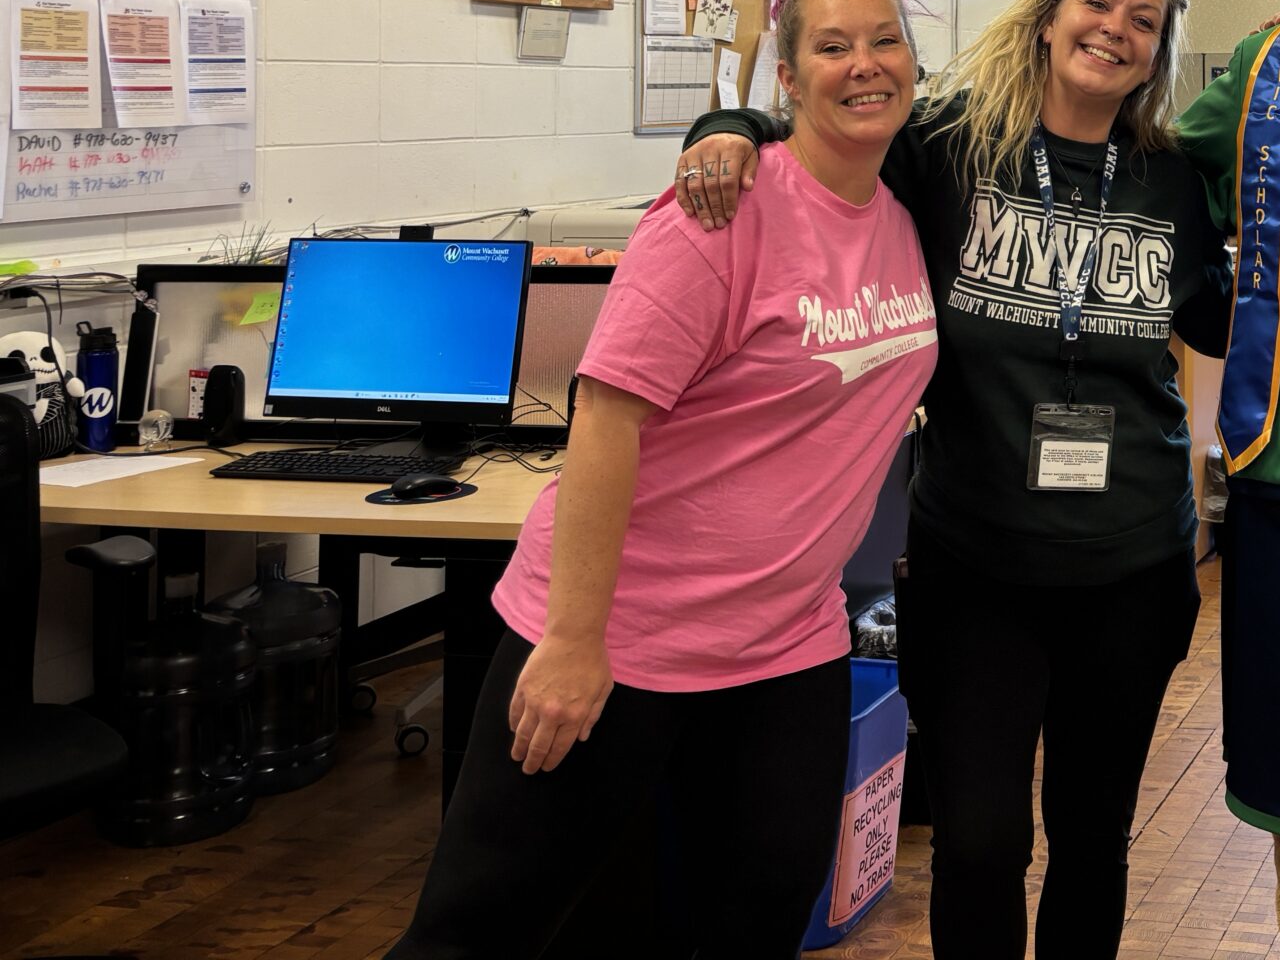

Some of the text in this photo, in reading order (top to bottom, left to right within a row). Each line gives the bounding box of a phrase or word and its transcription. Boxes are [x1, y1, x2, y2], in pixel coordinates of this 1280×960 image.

[1252, 144, 1274, 290] SCHOLAR
[959, 192, 1175, 309] MWCC
[798, 292, 869, 348] Mount
[947, 290, 984, 316] MOUNT
[986, 301, 1061, 330] WACHUSETT
[1137, 323, 1170, 339] COLLEGE
[860, 337, 920, 371] COMMUNITY COLLEGE
[377, 405, 392, 413] DELL
[853, 782, 903, 837] RECYCLING
[864, 767, 895, 803] PAPER
[857, 834, 892, 880] PLEASE
[865, 818, 890, 849] ONLY
[849, 853, 895, 909] NO TRASH
